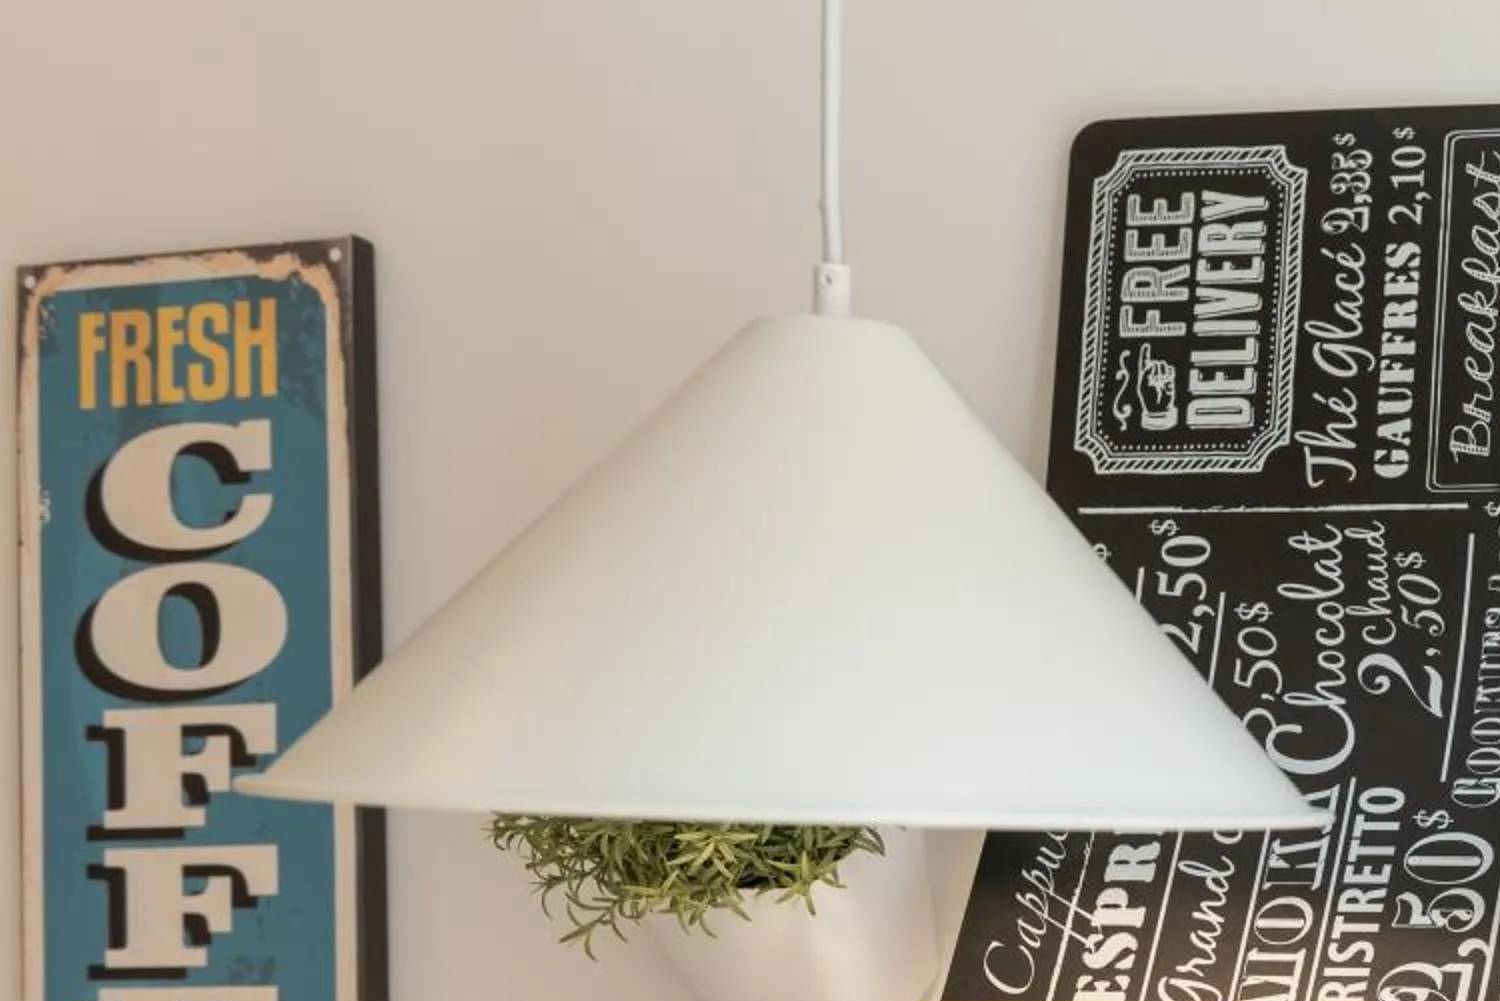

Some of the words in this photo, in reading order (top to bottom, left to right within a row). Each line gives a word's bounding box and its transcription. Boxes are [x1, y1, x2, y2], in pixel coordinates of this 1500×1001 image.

[77, 297, 279, 409] FRESH
[1119, 192, 1195, 338] FREE
[1186, 190, 1268, 429] DELIVERY
[1373, 241, 1422, 478] GAUFFRES
[1295, 388, 1359, 489] Thé
[1265, 523, 1355, 775] Chocolat
